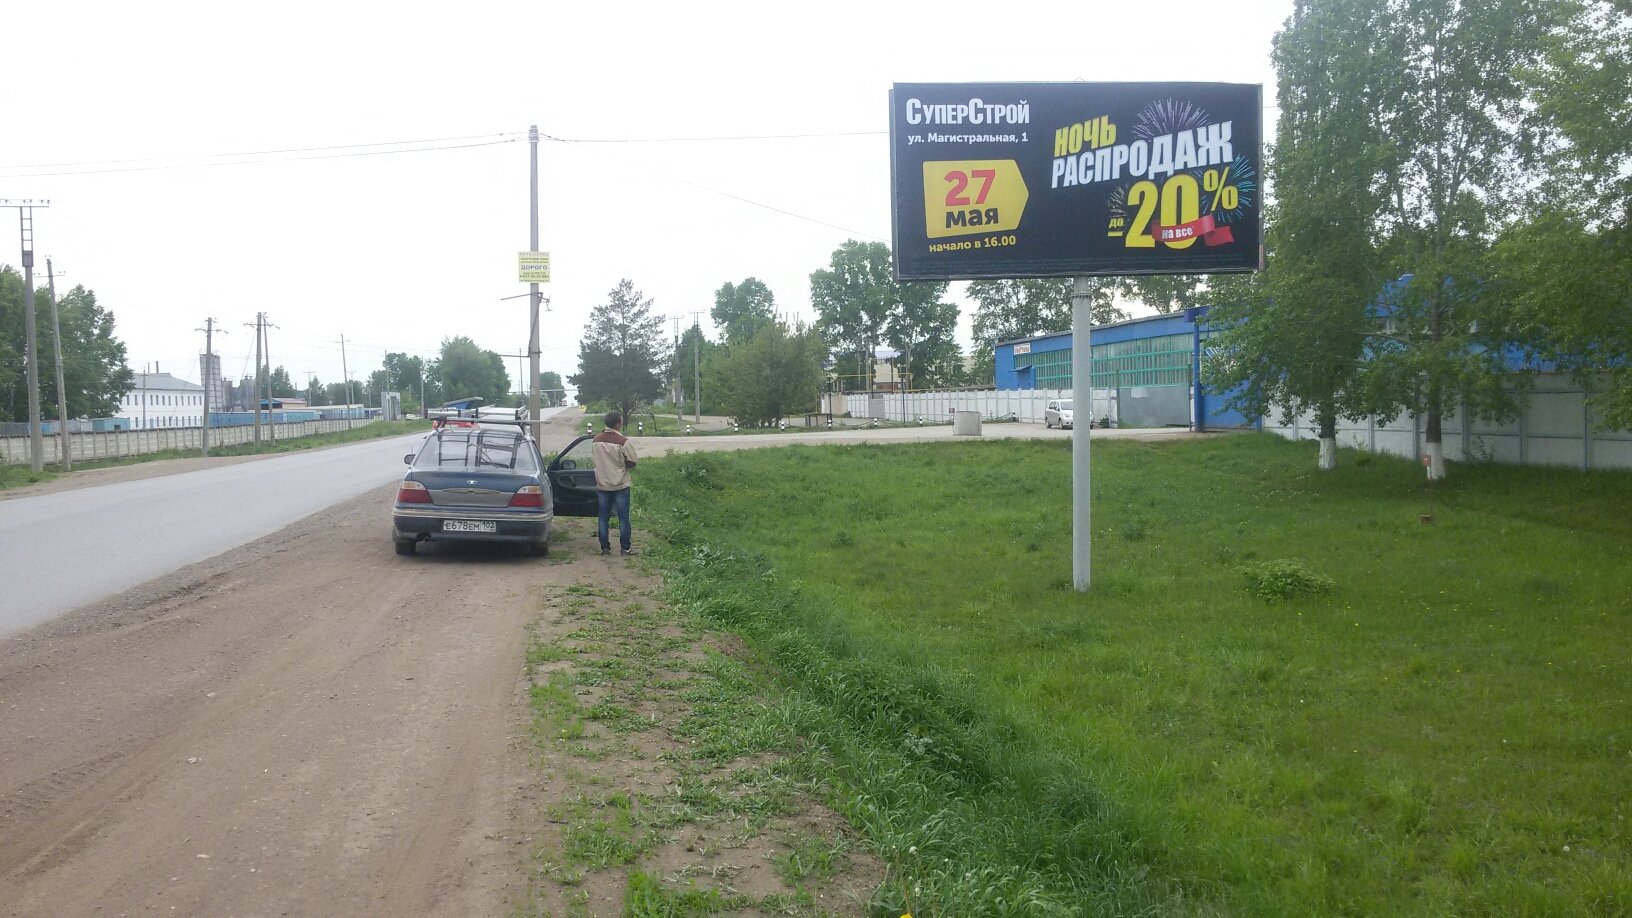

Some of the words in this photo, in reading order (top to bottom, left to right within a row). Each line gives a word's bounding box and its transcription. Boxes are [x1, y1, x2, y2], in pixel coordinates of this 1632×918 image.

[908, 135, 925, 145] ул.
[928, 132, 1019, 144] Магистральная,
[1021, 132, 1029, 142] 1
[1053, 115, 1117, 158] НОЧЬ
[1051, 120, 1233, 189] РАСПРОДАЖ
[944, 169, 996, 207] 27
[945, 207, 999, 229] мая
[929, 241, 972, 253] начало
[974, 240, 982, 249] в
[984, 235, 1017, 248] 16.00
